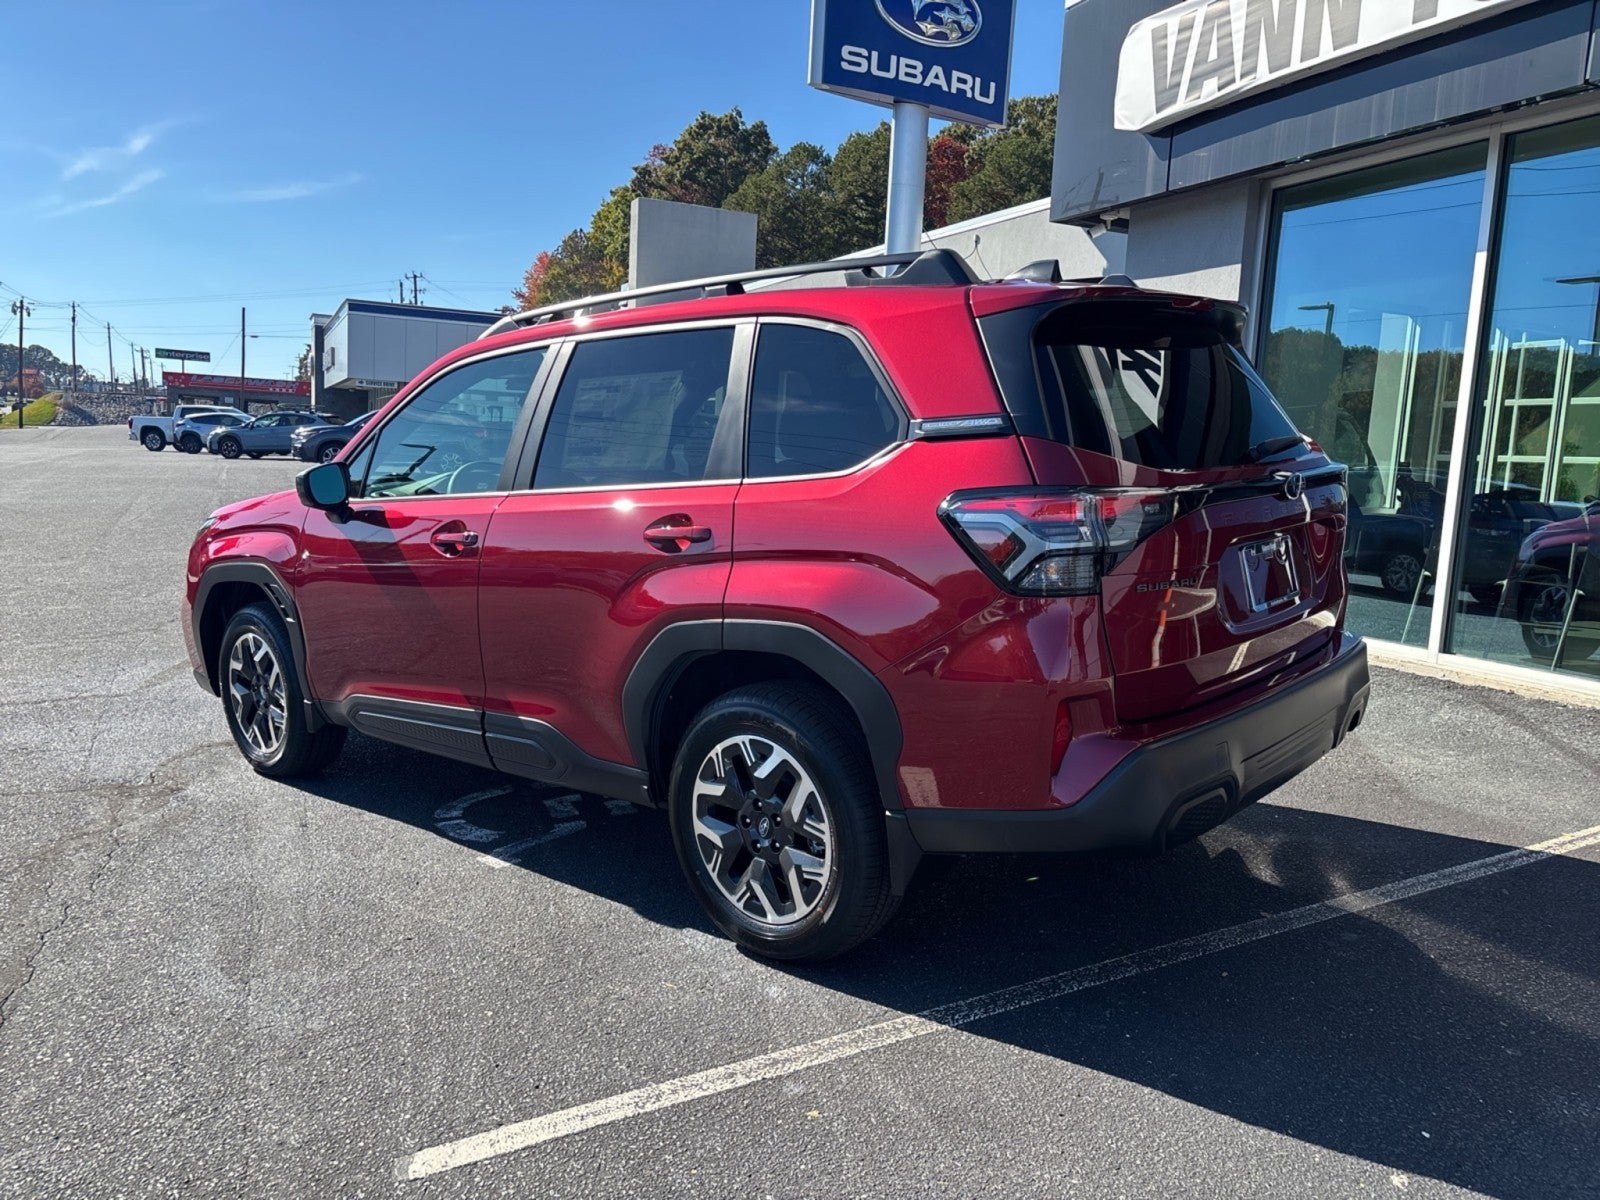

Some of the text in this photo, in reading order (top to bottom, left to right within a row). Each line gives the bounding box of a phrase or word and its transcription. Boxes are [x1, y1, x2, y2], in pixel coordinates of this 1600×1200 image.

[840, 45, 996, 105] SUBARU
[1151, 0, 1363, 115] VANN
[157, 350, 210, 361] enterprise
[1136, 577, 1199, 593] SUBARU
